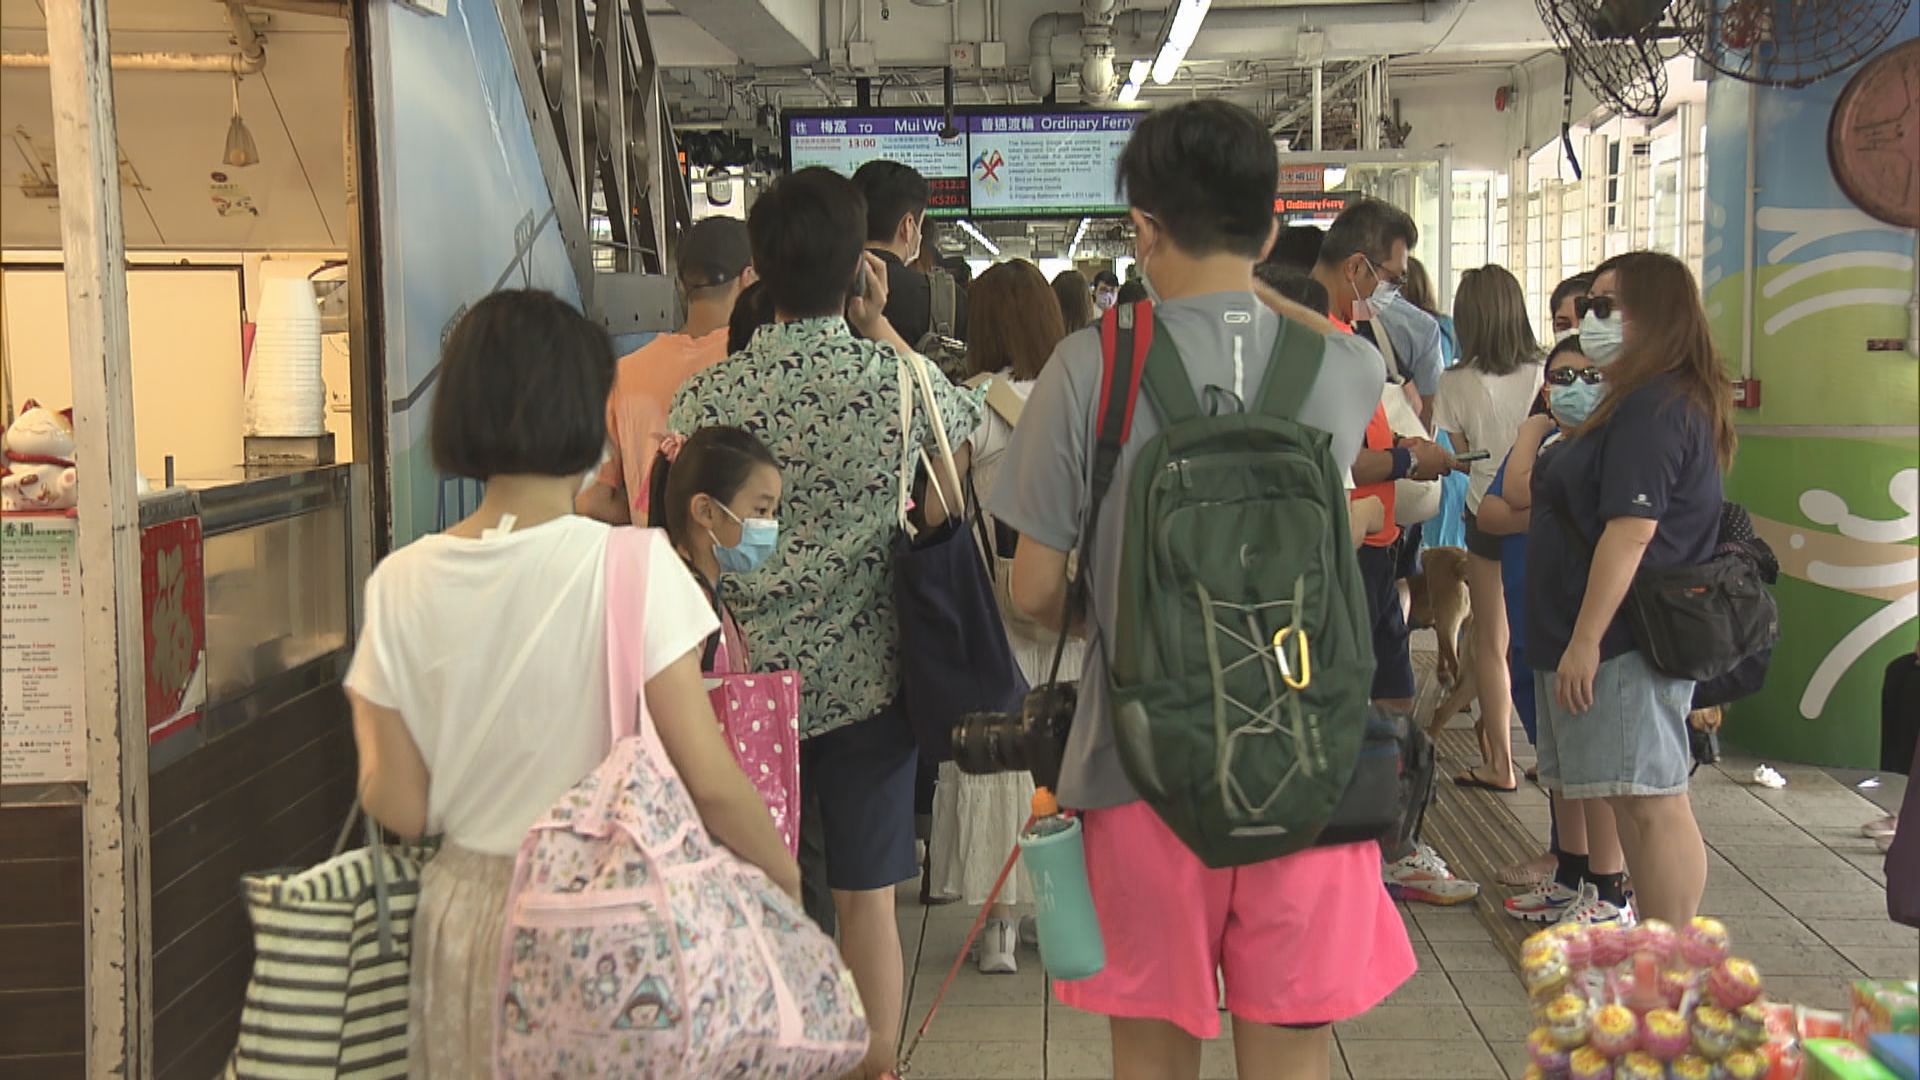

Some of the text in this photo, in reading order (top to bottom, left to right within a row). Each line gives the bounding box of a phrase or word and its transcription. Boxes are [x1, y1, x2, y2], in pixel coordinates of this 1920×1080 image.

[820, 119, 847, 134] 梅窩
[858, 123, 873, 133] TO
[894, 118, 920, 132] Mui
[981, 115, 1135, 132] 普通渡輪 Ordinary Ferry
[848, 138, 876, 148] 13:00
